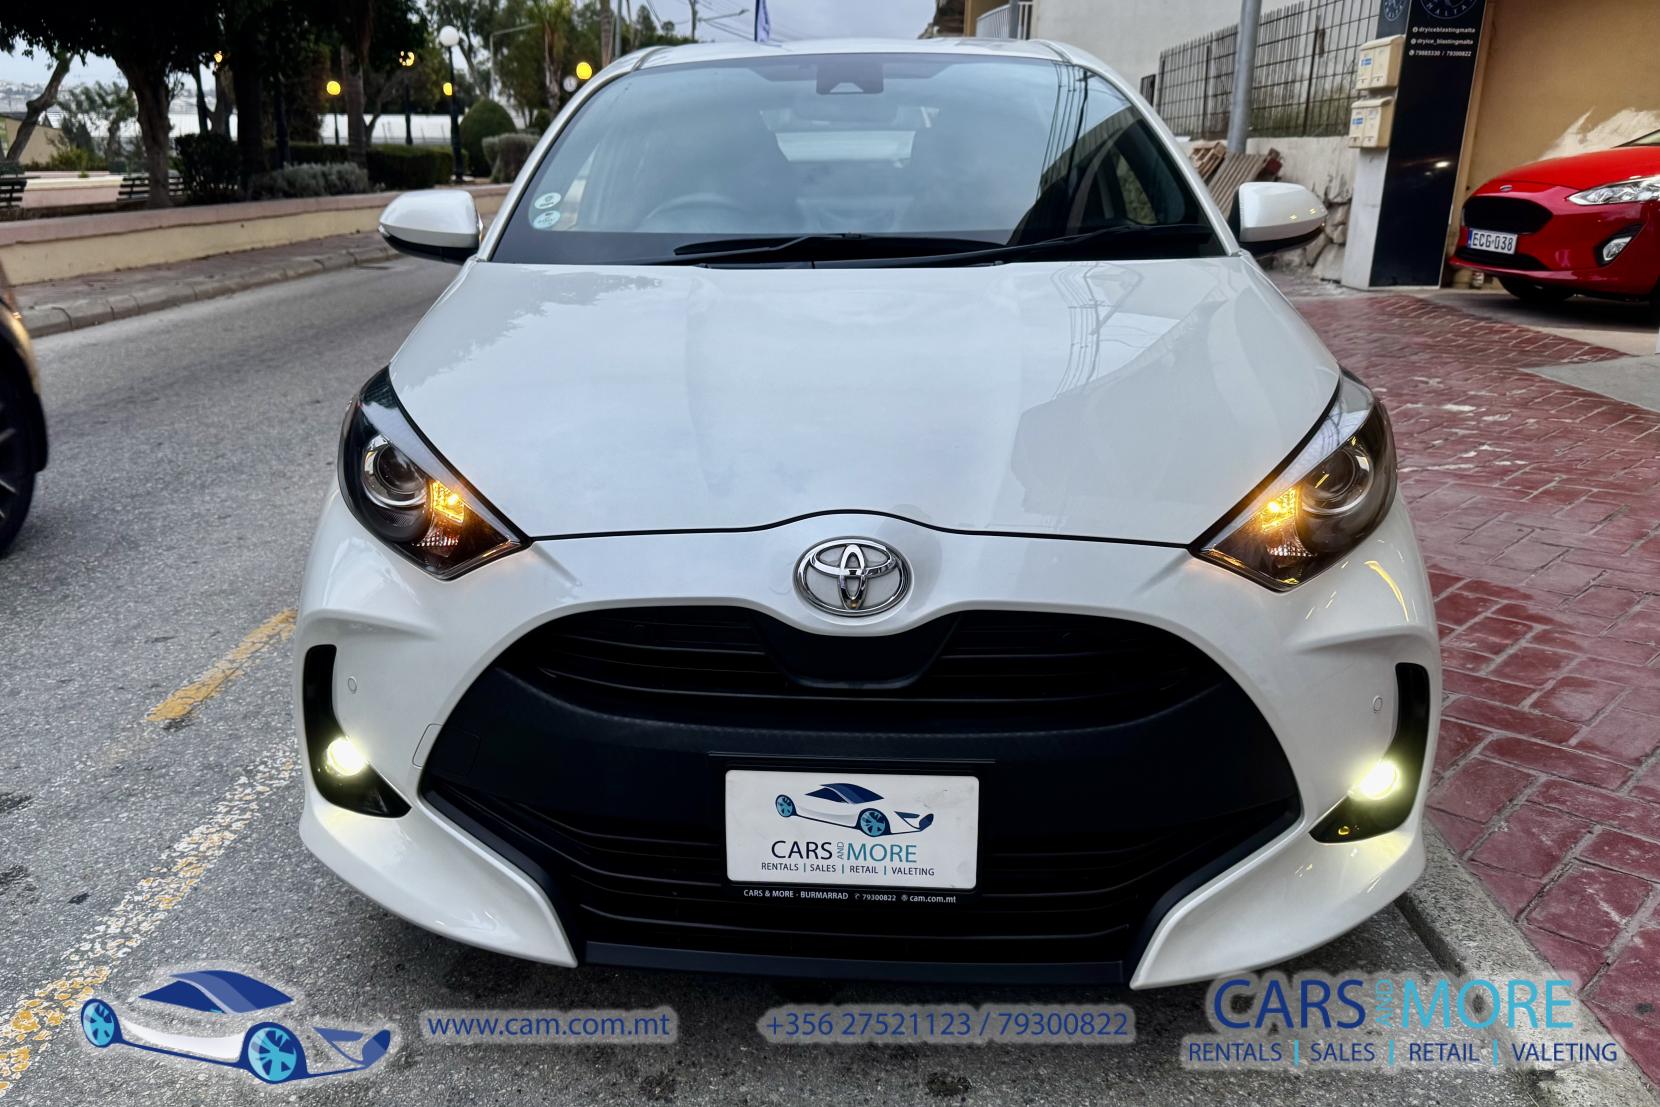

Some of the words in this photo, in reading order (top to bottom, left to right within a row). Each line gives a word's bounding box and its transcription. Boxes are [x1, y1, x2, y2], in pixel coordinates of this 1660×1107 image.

[771, 840, 833, 860] CARS
[837, 841, 845, 860] AND
[847, 842, 917, 863] MORE
[761, 862, 799, 872] RENTALS
[809, 863, 837, 873] SALES
[849, 865, 879, 875] RETAIL
[891, 866, 935, 877] VALETING
[743, 889, 763, 897] CARS
[764, 890, 771, 898] &
[772, 890, 795, 898] MORE
[800, 890, 849, 900] BURMARRAD
[862, 893, 897, 901] 79300822
[909, 895, 957, 903] cam.com.mt
